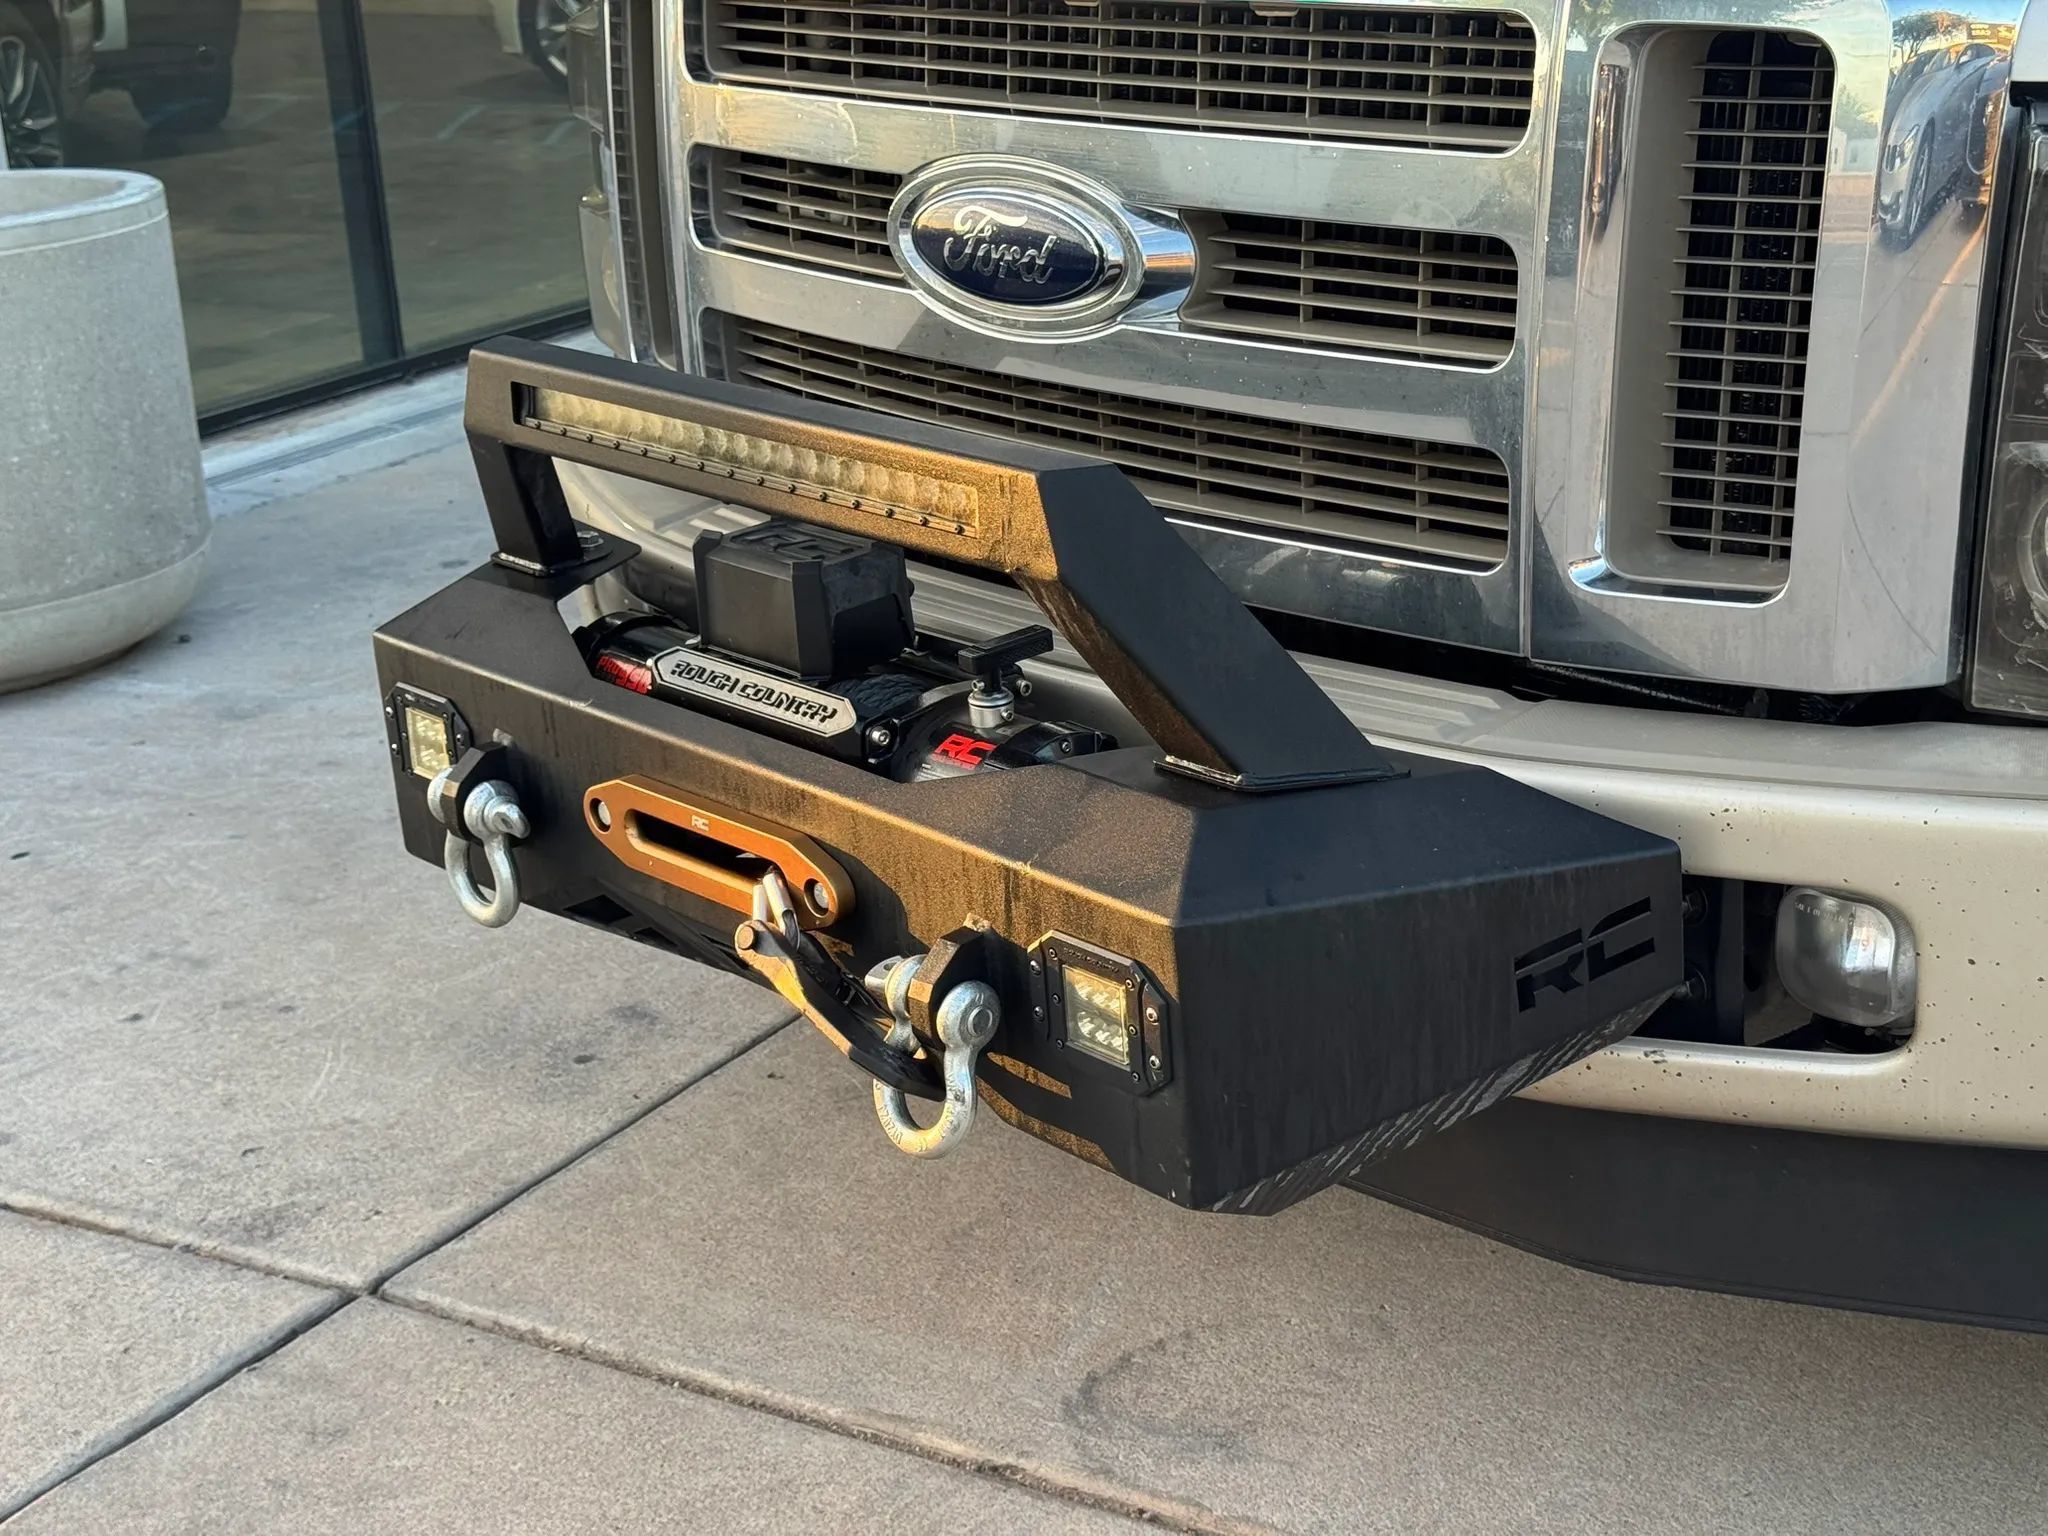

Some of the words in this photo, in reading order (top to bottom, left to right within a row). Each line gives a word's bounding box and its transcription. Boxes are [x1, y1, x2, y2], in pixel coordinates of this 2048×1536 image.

[943, 205, 1055, 284] Ford
[670, 659, 741, 693] ROUGH
[737, 682, 838, 724] COUNTRY
[934, 733, 998, 765] RC
[691, 814, 709, 832] RC
[1513, 895, 1656, 1013] RC
